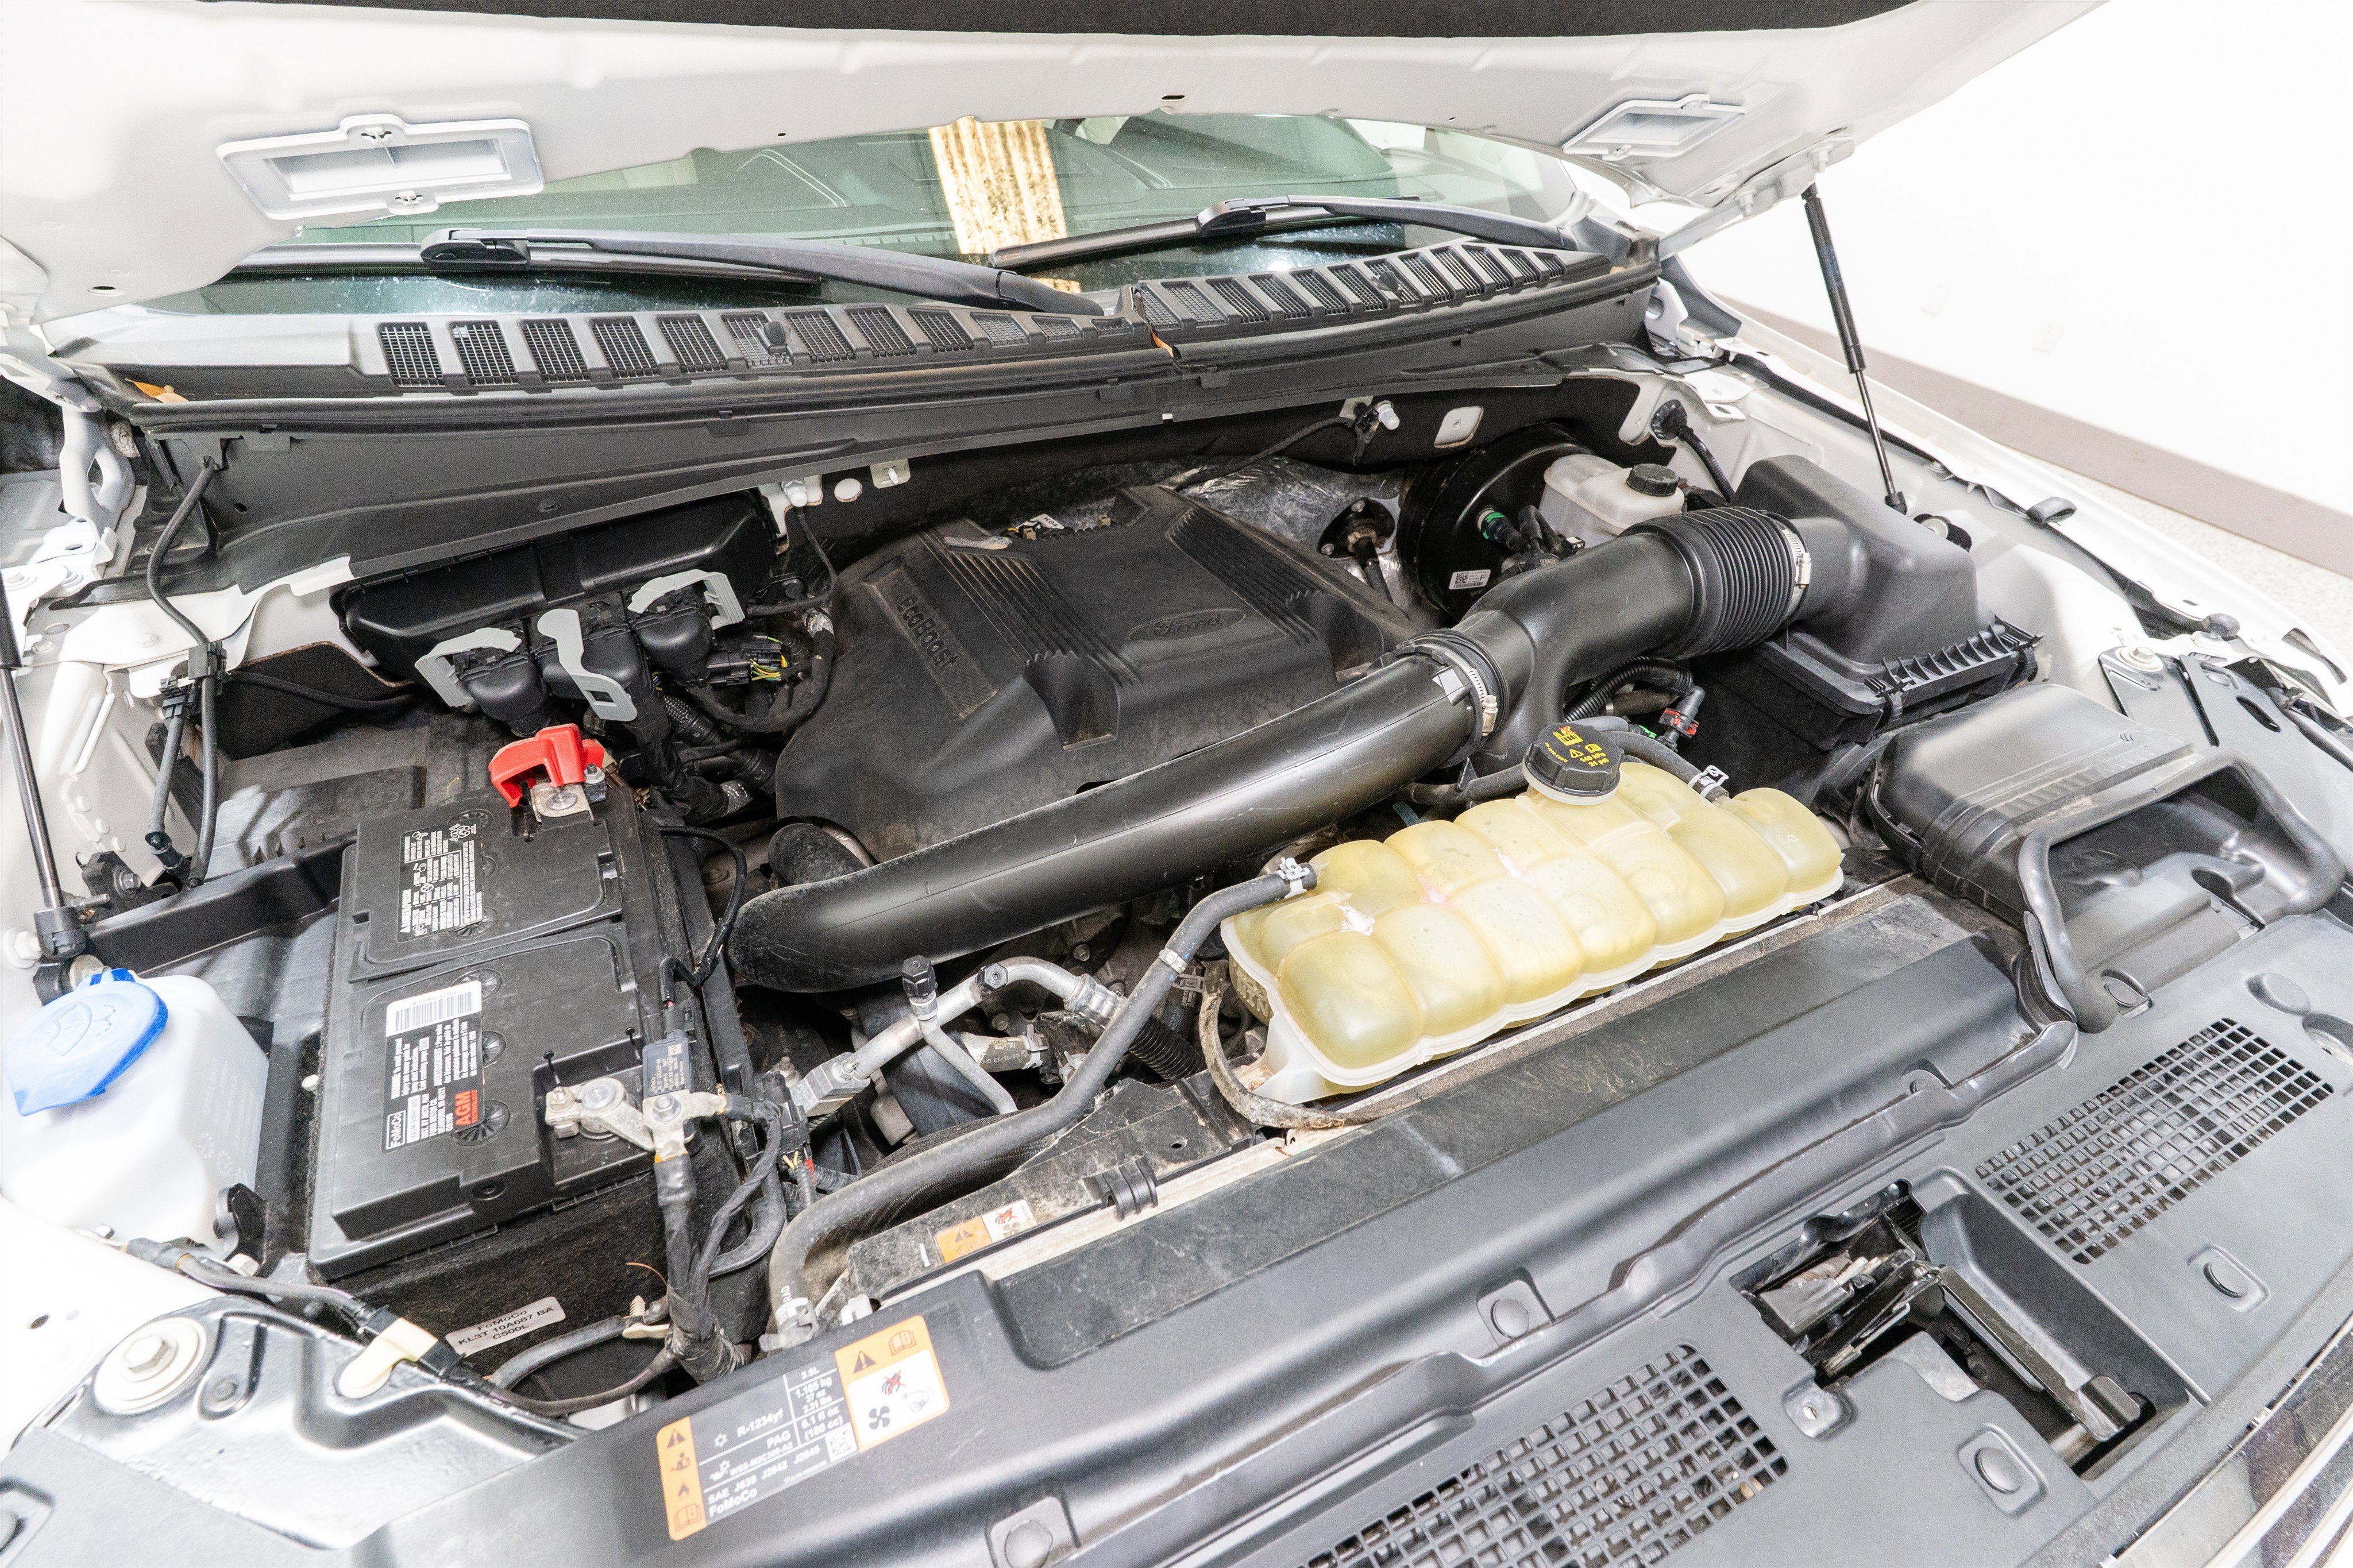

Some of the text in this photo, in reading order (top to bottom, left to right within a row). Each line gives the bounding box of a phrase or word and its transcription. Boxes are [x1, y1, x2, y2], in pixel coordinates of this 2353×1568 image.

[1043, 517, 1058, 526] K04
[896, 593, 960, 673] EcoBoost
[1153, 613, 1225, 637] Ford
[454, 1090, 470, 1128] AGM
[391, 1113, 402, 1146] FoMoCo
[780, 1285, 792, 1303] RAD
[458, 1307, 554, 1345] KL3T 10A687 BA
[476, 1311, 527, 1331] FoMoCo
[492, 1325, 529, 1339] C500L
[737, 1408, 783, 1437] R-1234yf
[767, 1430, 790, 1449] PAG
[708, 1488, 730, 1504] SAE
[709, 1488, 757, 1517] FoMoCo
